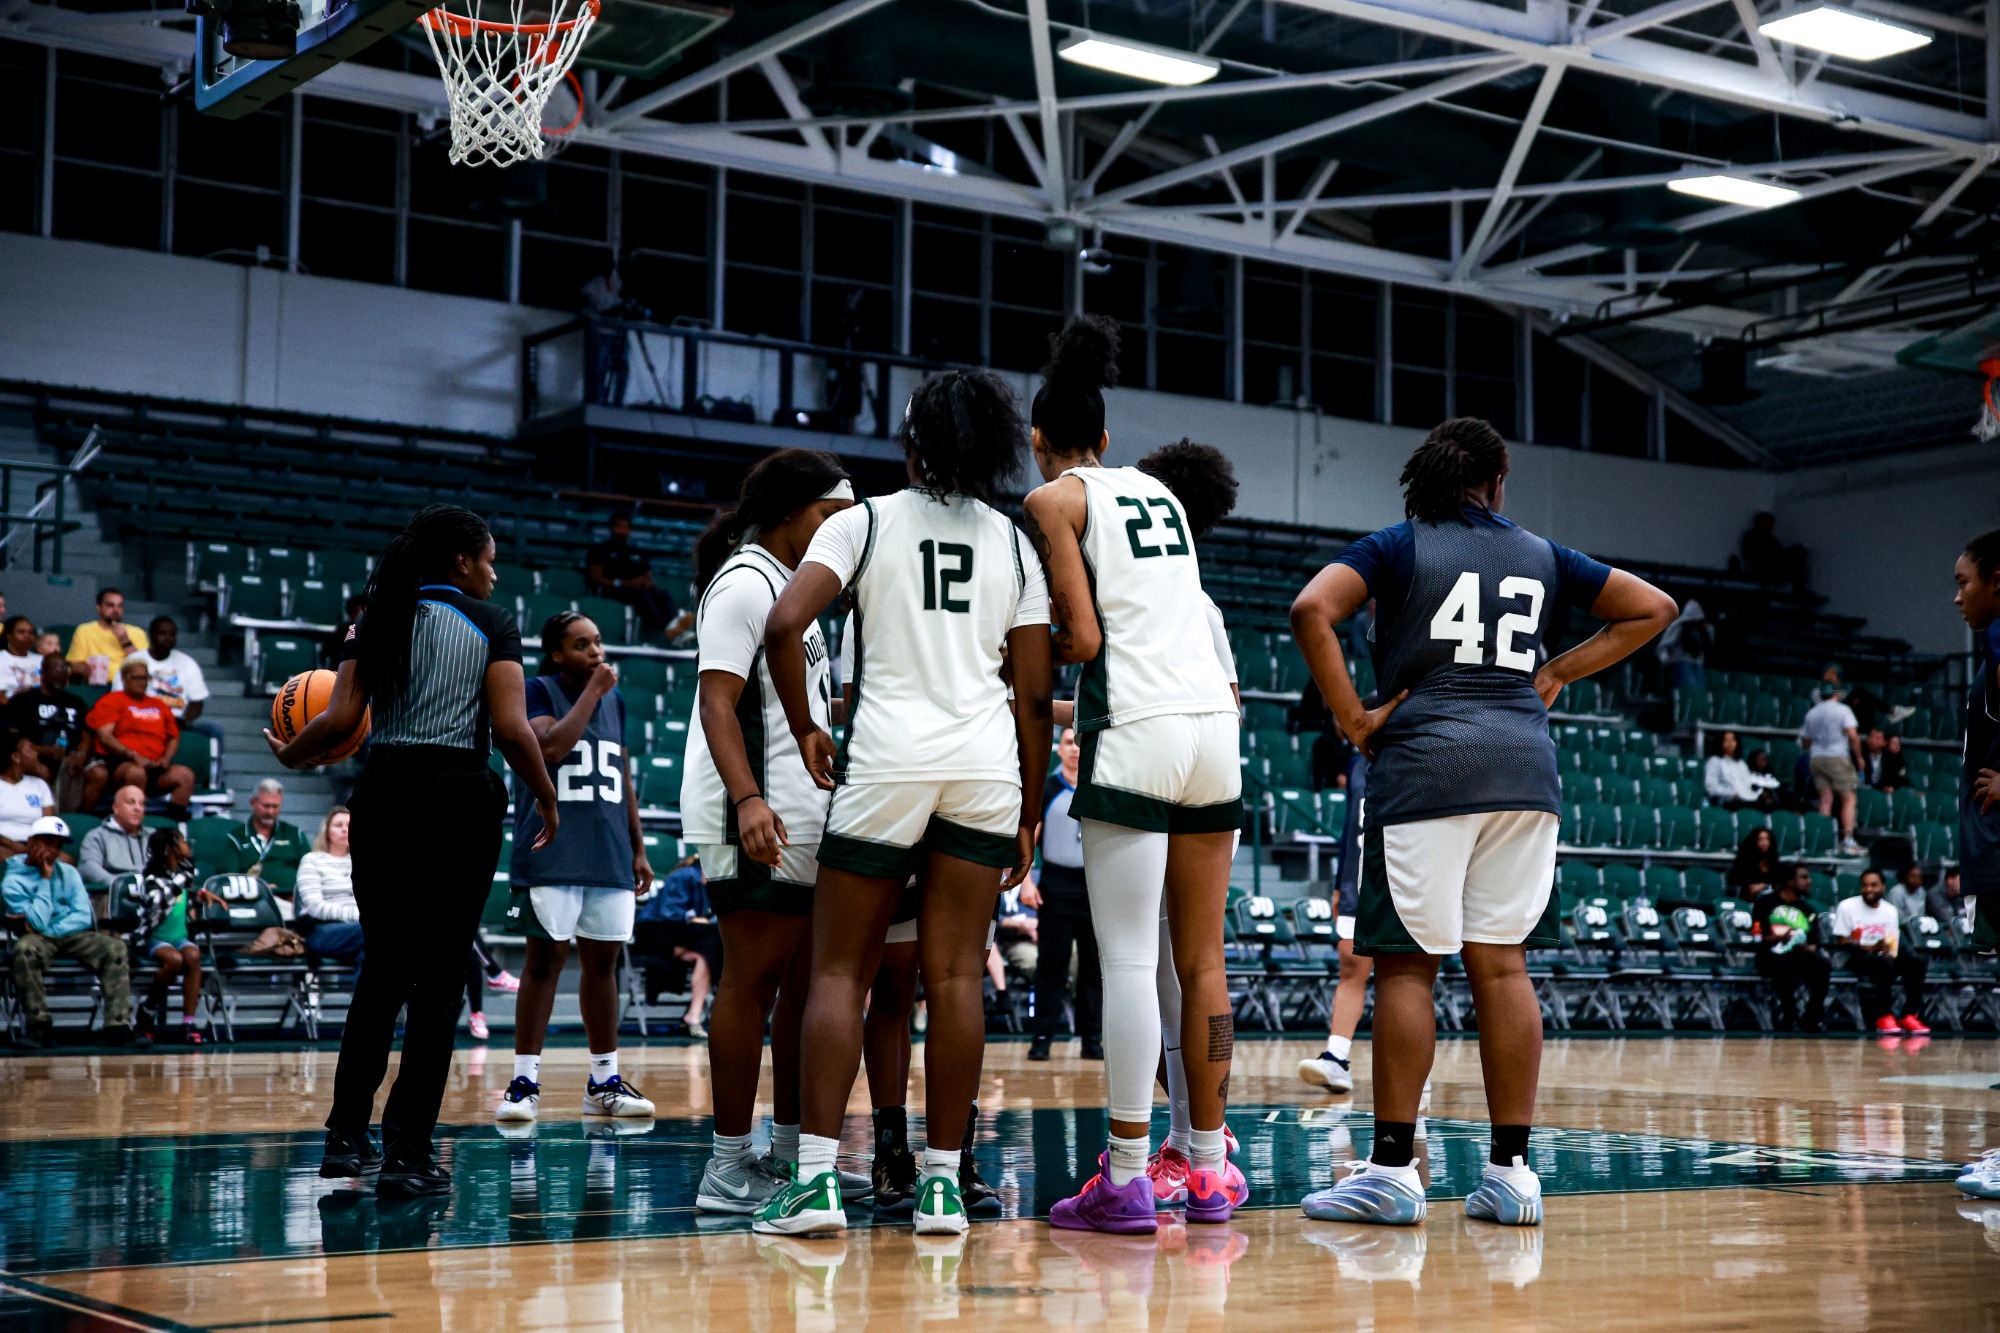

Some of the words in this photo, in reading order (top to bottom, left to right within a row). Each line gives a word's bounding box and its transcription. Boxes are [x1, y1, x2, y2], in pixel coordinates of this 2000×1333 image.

[1115, 495, 1190, 559] 23
[919, 538, 974, 613] 12
[1430, 571, 1545, 673] 42
[282, 676, 301, 738] Wilson
[557, 739, 623, 804] 25
[222, 874, 259, 899] JU
[506, 906, 520, 918] JU
